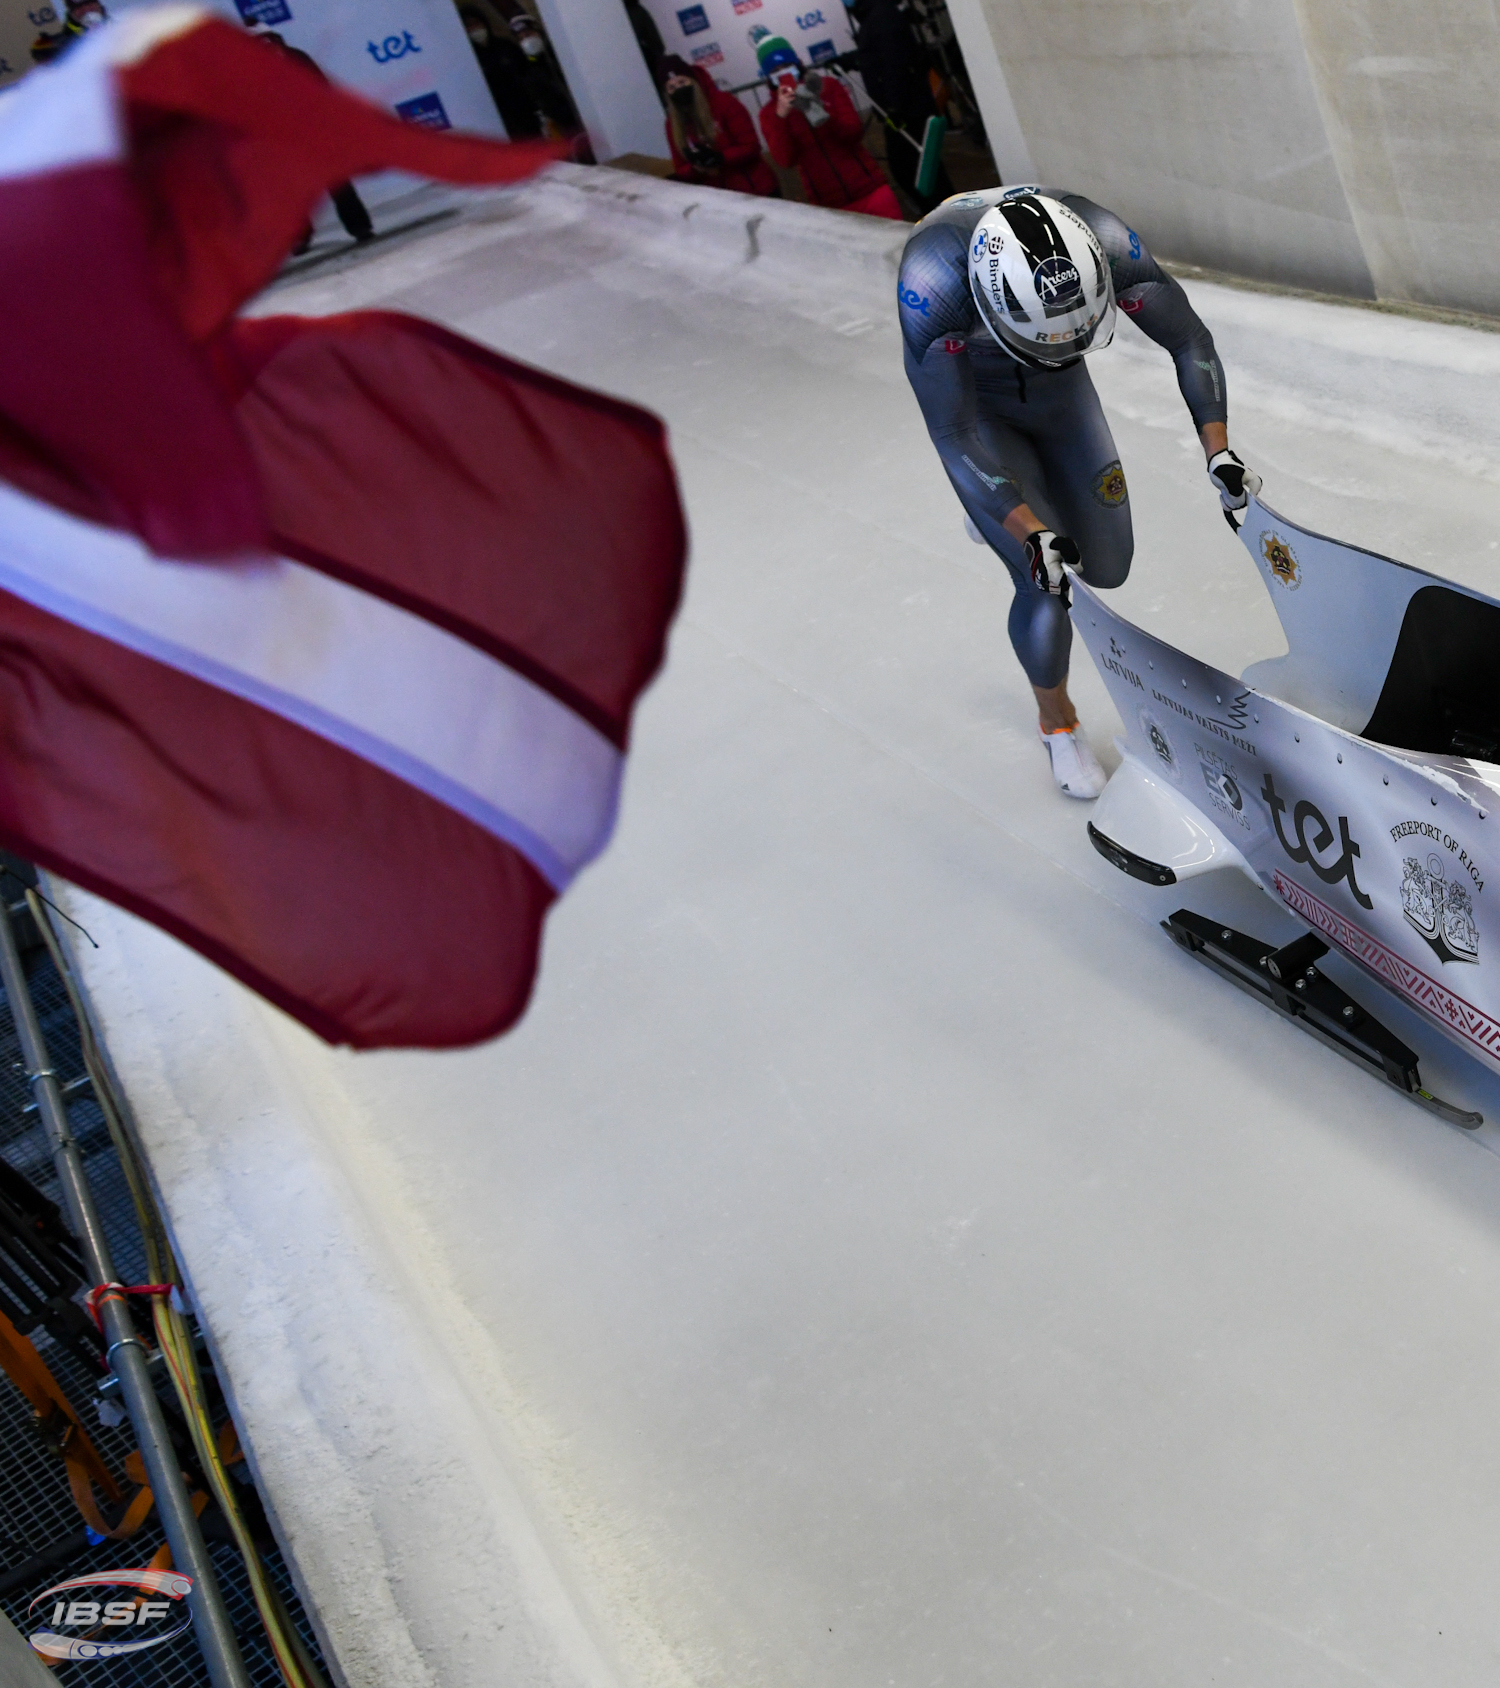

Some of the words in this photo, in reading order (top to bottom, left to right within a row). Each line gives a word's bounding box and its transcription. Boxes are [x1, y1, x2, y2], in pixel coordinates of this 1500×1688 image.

[366, 29, 422, 64] tet
[989, 258, 1005, 315] Binders
[1101, 652, 1145, 691] LATVIJA
[1151, 688, 1194, 721] LATVIJAS
[1195, 713, 1230, 742] VALSTS
[1194, 741, 1238, 781] PILSĒTAS
[1208, 792, 1251, 831] SERVISS
[1260, 773, 1374, 910] tet
[1390, 820, 1442, 844] FREEPORT
[1443, 834, 1459, 854] OF
[1458, 848, 1486, 894] RIGA
